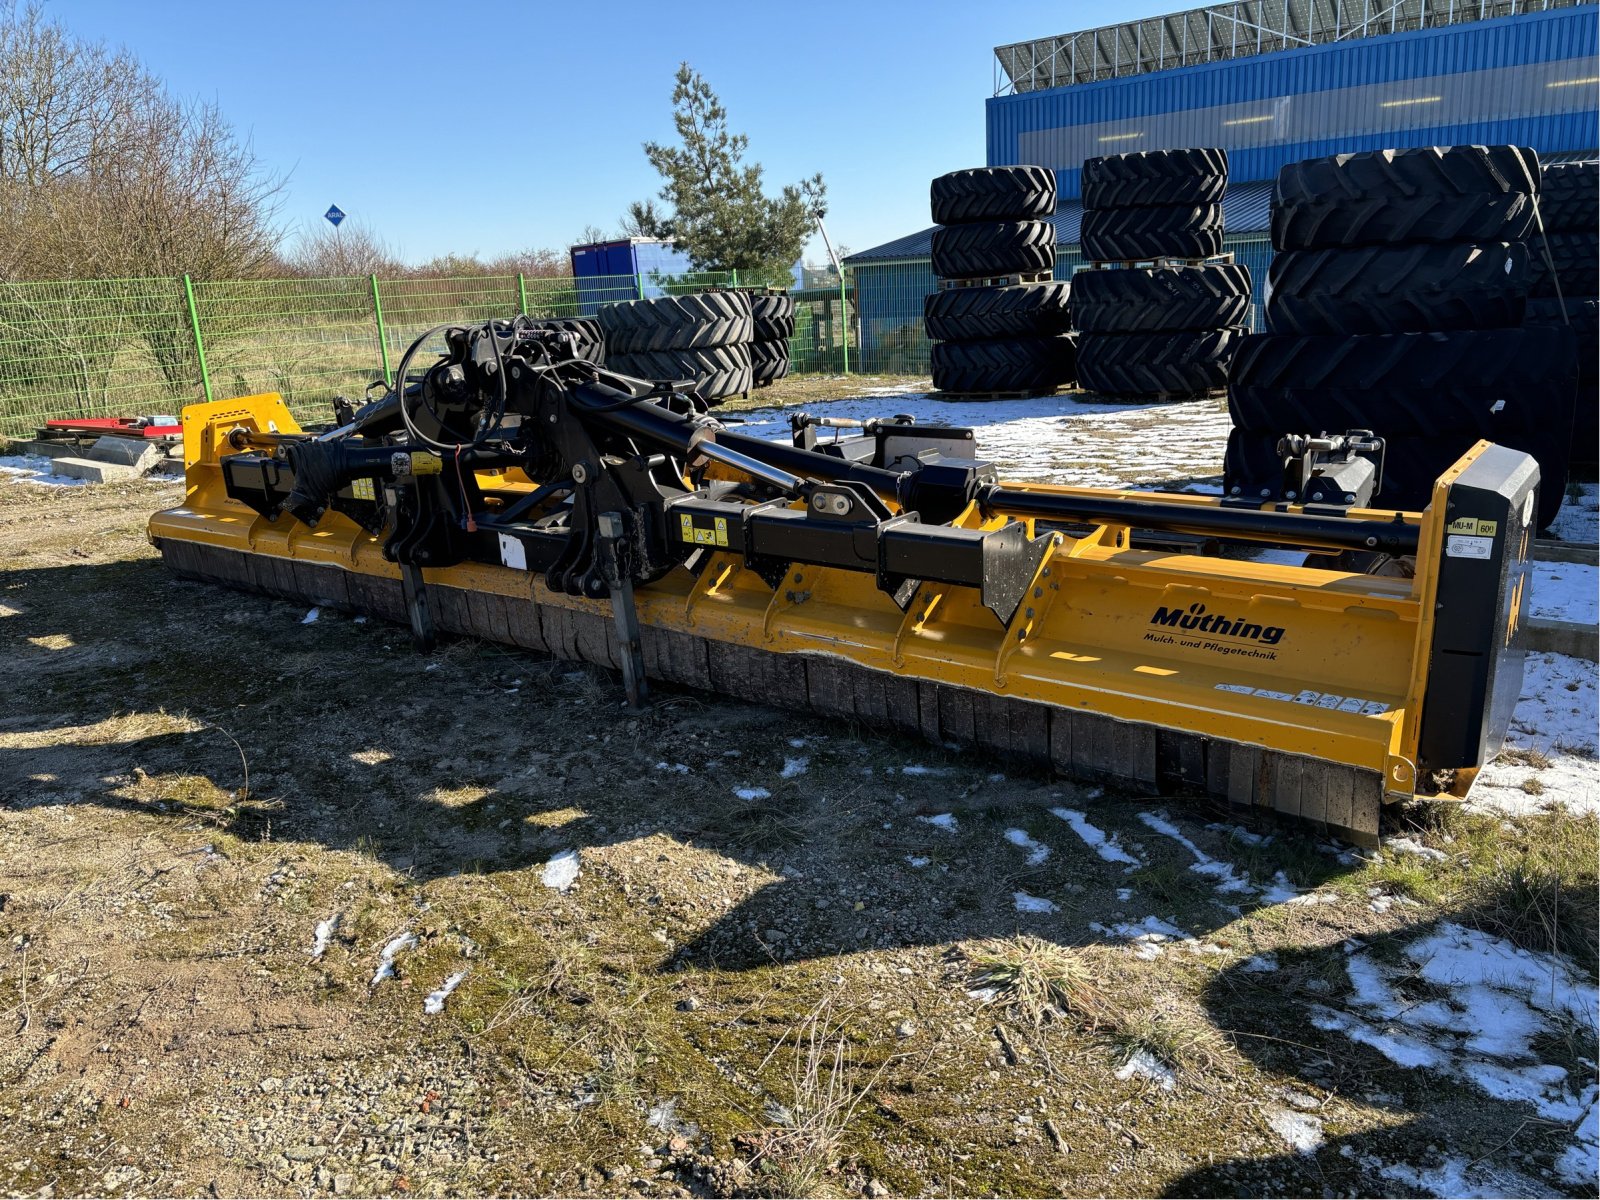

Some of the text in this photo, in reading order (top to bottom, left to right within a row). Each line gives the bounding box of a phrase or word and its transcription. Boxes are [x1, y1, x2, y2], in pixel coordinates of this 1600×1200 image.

[1452, 521, 1494, 533] MU-M 600
[1150, 602, 1286, 645] Müthing
[1143, 633, 1277, 660] Mulch- und Pflegetechnik
